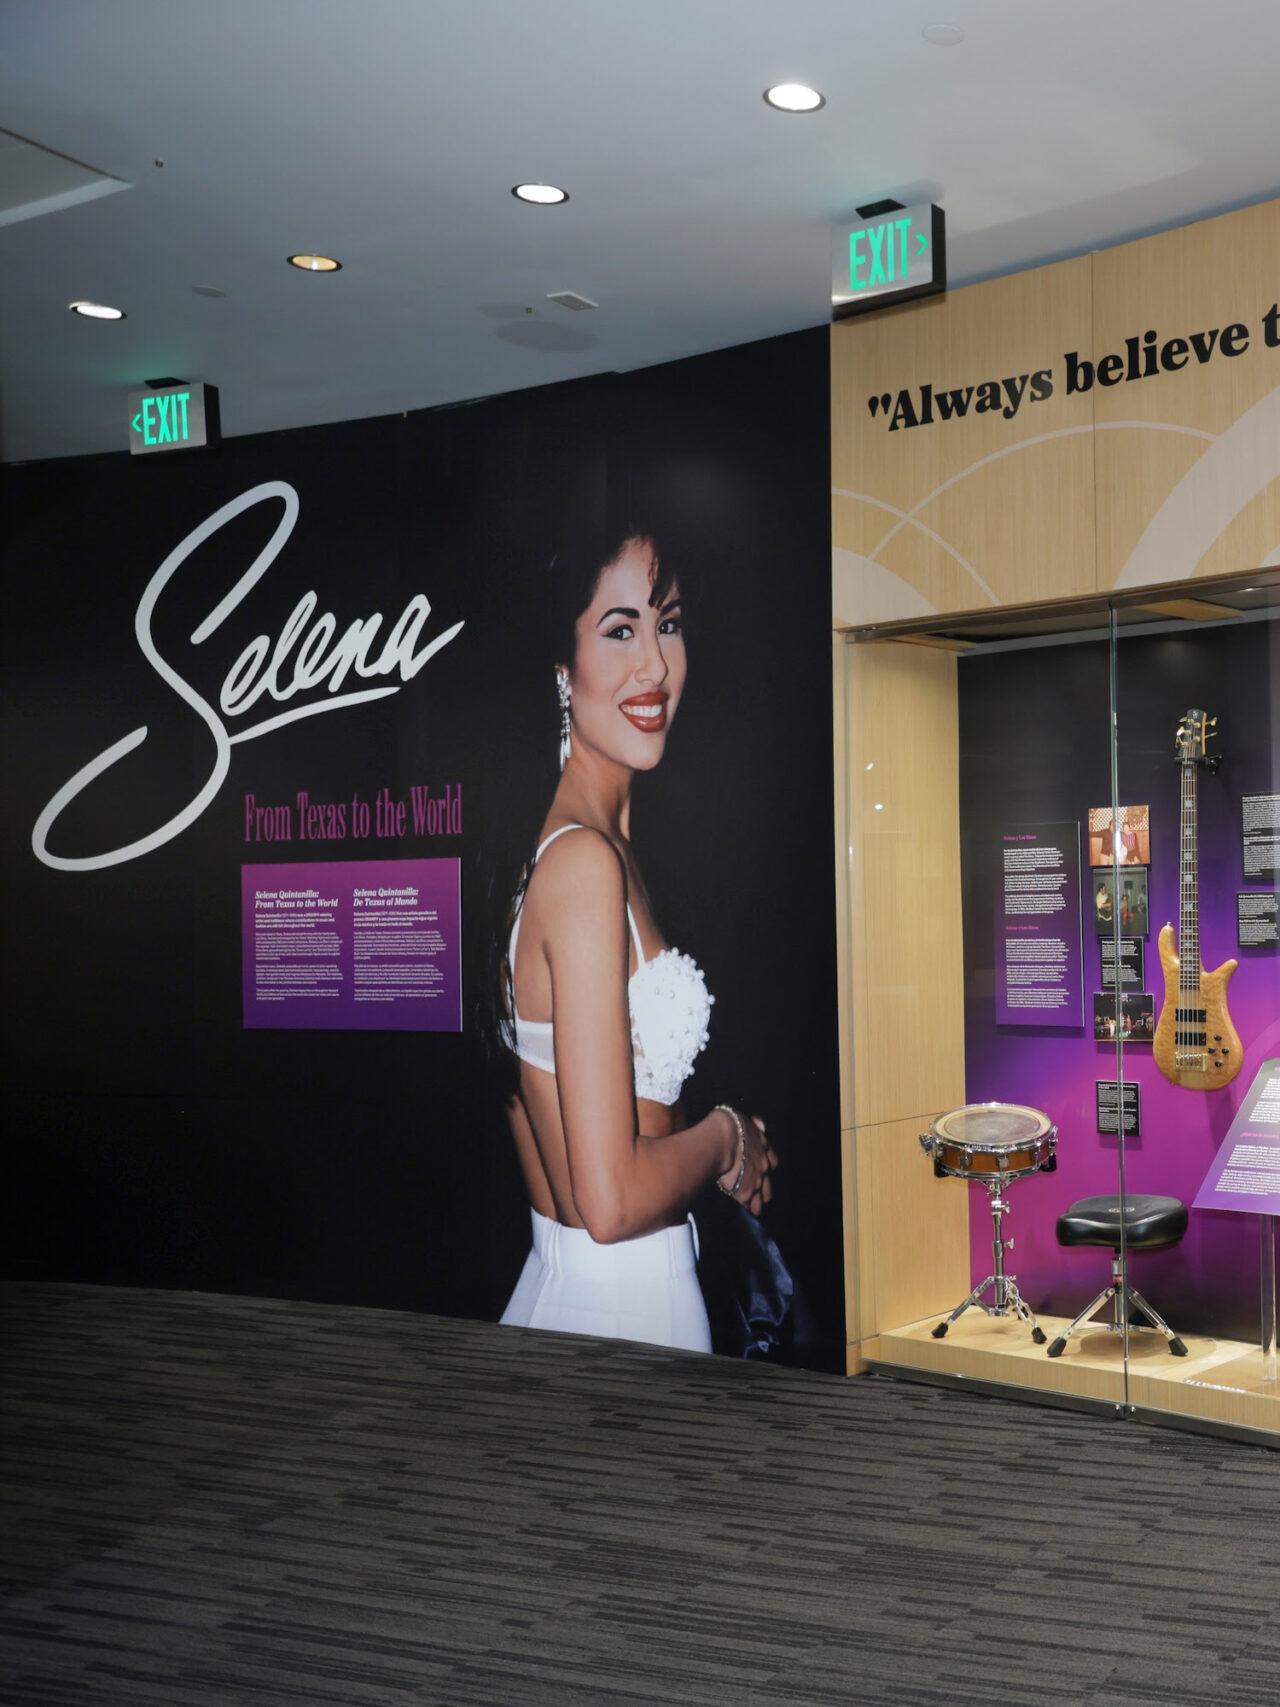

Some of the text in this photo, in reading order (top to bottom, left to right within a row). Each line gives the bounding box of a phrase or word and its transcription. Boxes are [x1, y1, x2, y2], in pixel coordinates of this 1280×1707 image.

[849, 218, 913, 291] EXIT
[1064, 324, 1250, 396] believe
[143, 392, 190, 445] EXIT
[32, 480, 465, 871] Selena
[245, 783, 463, 842] From Texas to the World
[255, 890, 278, 900] Selena
[255, 898, 339, 909] From Texas to the World
[353, 888, 377, 898] Selena
[353, 896, 418, 907] De Texas al Mundo
